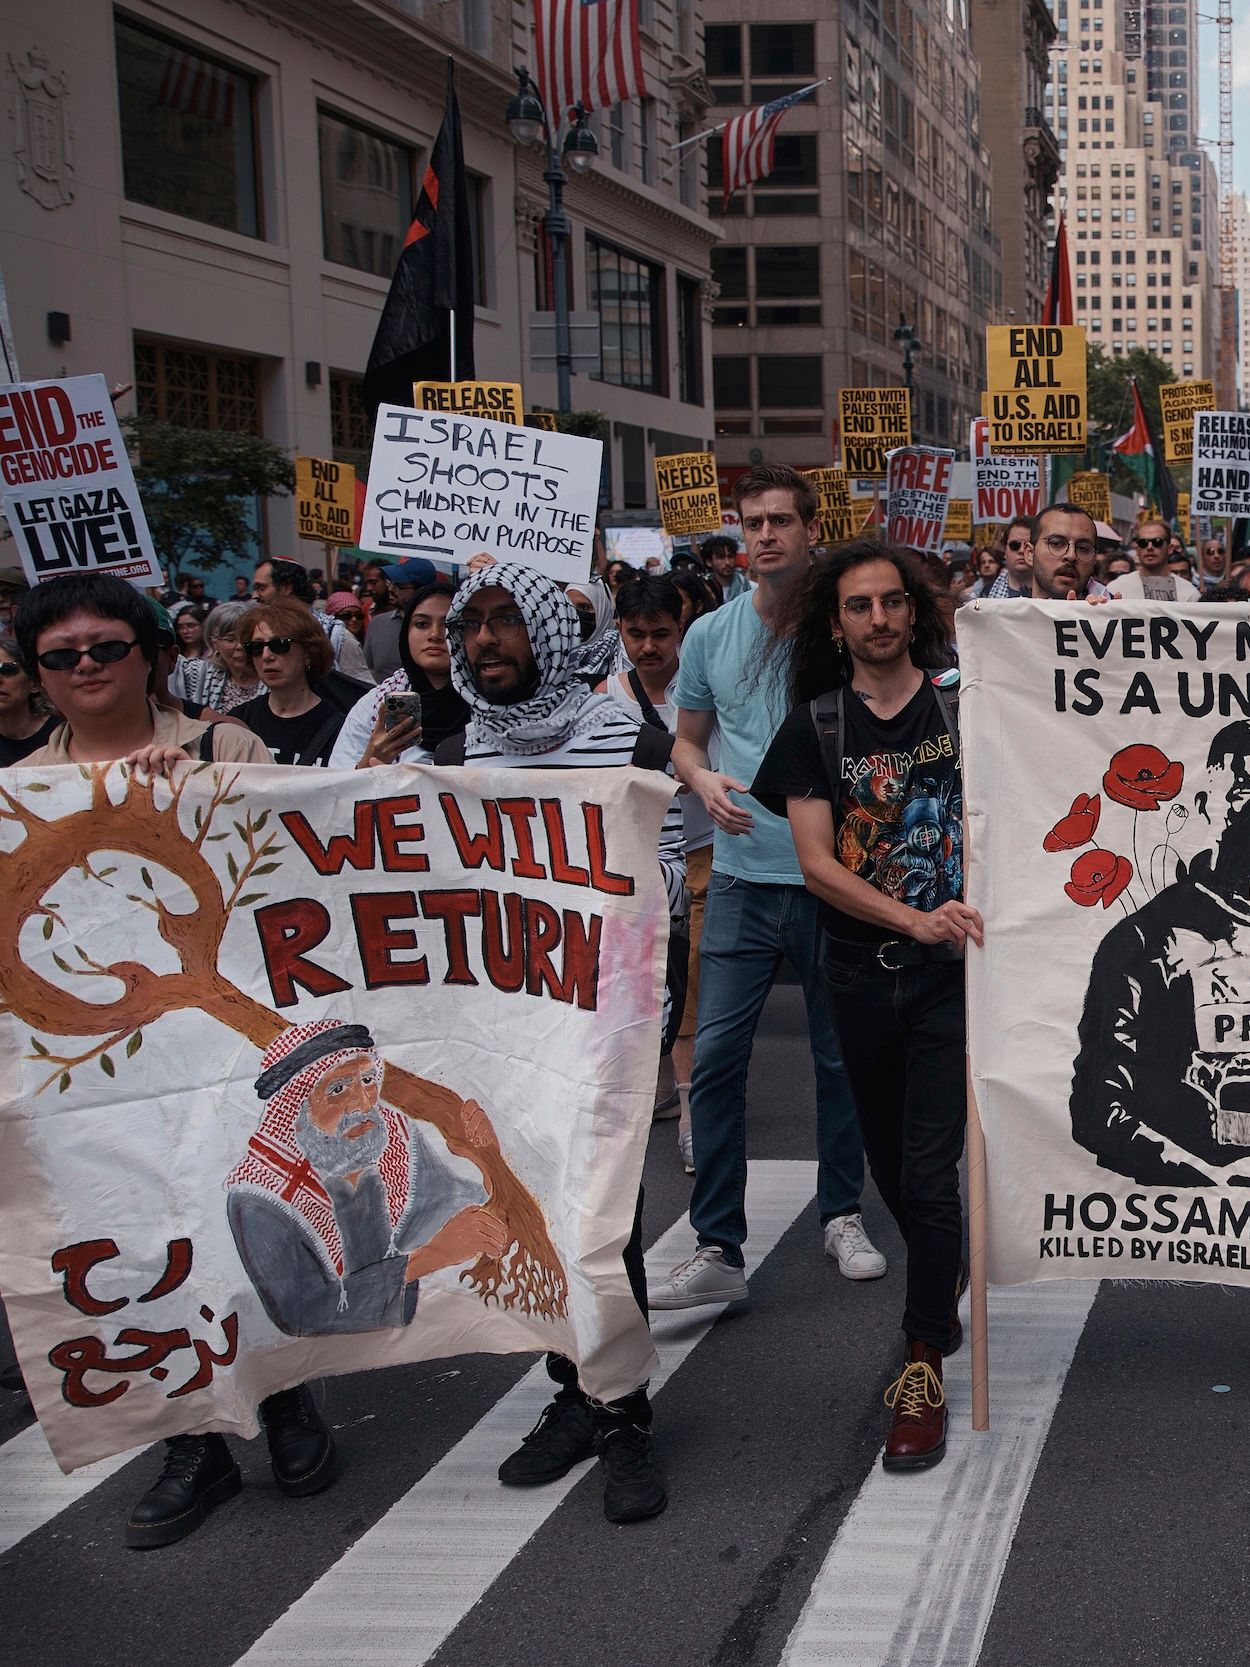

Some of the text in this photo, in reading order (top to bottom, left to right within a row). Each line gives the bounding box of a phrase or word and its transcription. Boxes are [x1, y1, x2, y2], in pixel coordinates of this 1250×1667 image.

[1010, 329, 1063, 357] END
[1014, 359, 1061, 388] ALL
[422, 388, 515, 411] RELEASE
[842, 390, 906, 402] STAND WITH
[1162, 384, 1212, 399] PROTESTING
[1164, 397, 1213, 407] AGAINST
[843, 403, 906, 415] PALESTINE!
[994, 394, 1080, 420] U.S. AID
[0, 386, 77, 453] END
[77, 411, 105, 429] THE
[844, 416, 908, 433] END THE
[383, 412, 568, 473] ISRAEL
[844, 436, 908, 447] OCCUPATION
[992, 423, 1013, 441] TO
[1018, 422, 1082, 441] ISRAEL!
[1171, 427, 1193, 441] IS NO
[1, 439, 118, 485] GENOCIDE
[312, 460, 339, 482] END
[657, 455, 712, 469] FUND PEOPLE'S
[889, 454, 952, 493] FREE
[976, 459, 1039, 467] PALESTIN
[398, 453, 559, 501] SHOOTS
[658, 465, 714, 491] NEEDS
[977, 470, 1038, 480] END TH
[314, 480, 337, 503] ALL
[816, 481, 848, 493] STINE!
[14, 487, 129, 526] LET GAZA
[375, 488, 590, 533] CHILDREN IN THE
[662, 493, 717, 512] NOT WAR
[824, 492, 850, 508] THE
[911, 500, 945, 513] THE
[1196, 501, 1215, 511] OUR
[299, 519, 313, 532] TO
[328, 506, 349, 525] AID
[663, 507, 709, 522] GENOCIDE
[712, 506, 718, 515] &
[889, 508, 943, 520] UPATION
[381, 516, 446, 540] HEAD
[454, 523, 490, 542] ON
[496, 525, 585, 558] PURPOSE
[817, 518, 853, 541] OW!
[23, 512, 143, 571] LIVE!
[1054, 617, 1217, 661] EVERY
[1054, 669, 1103, 716] IS
[1120, 672, 1161, 715] A
[841, 735, 954, 784] RON MIDE
[279, 792, 636, 896] WE WILL
[254, 889, 603, 1012] RETURN
[1040, 1237, 1123, 1259] KILLED
[1131, 1238, 1163, 1261] BY
[51, 1237, 193, 1317] رح
[48, 1303, 239, 1408] نرجع
